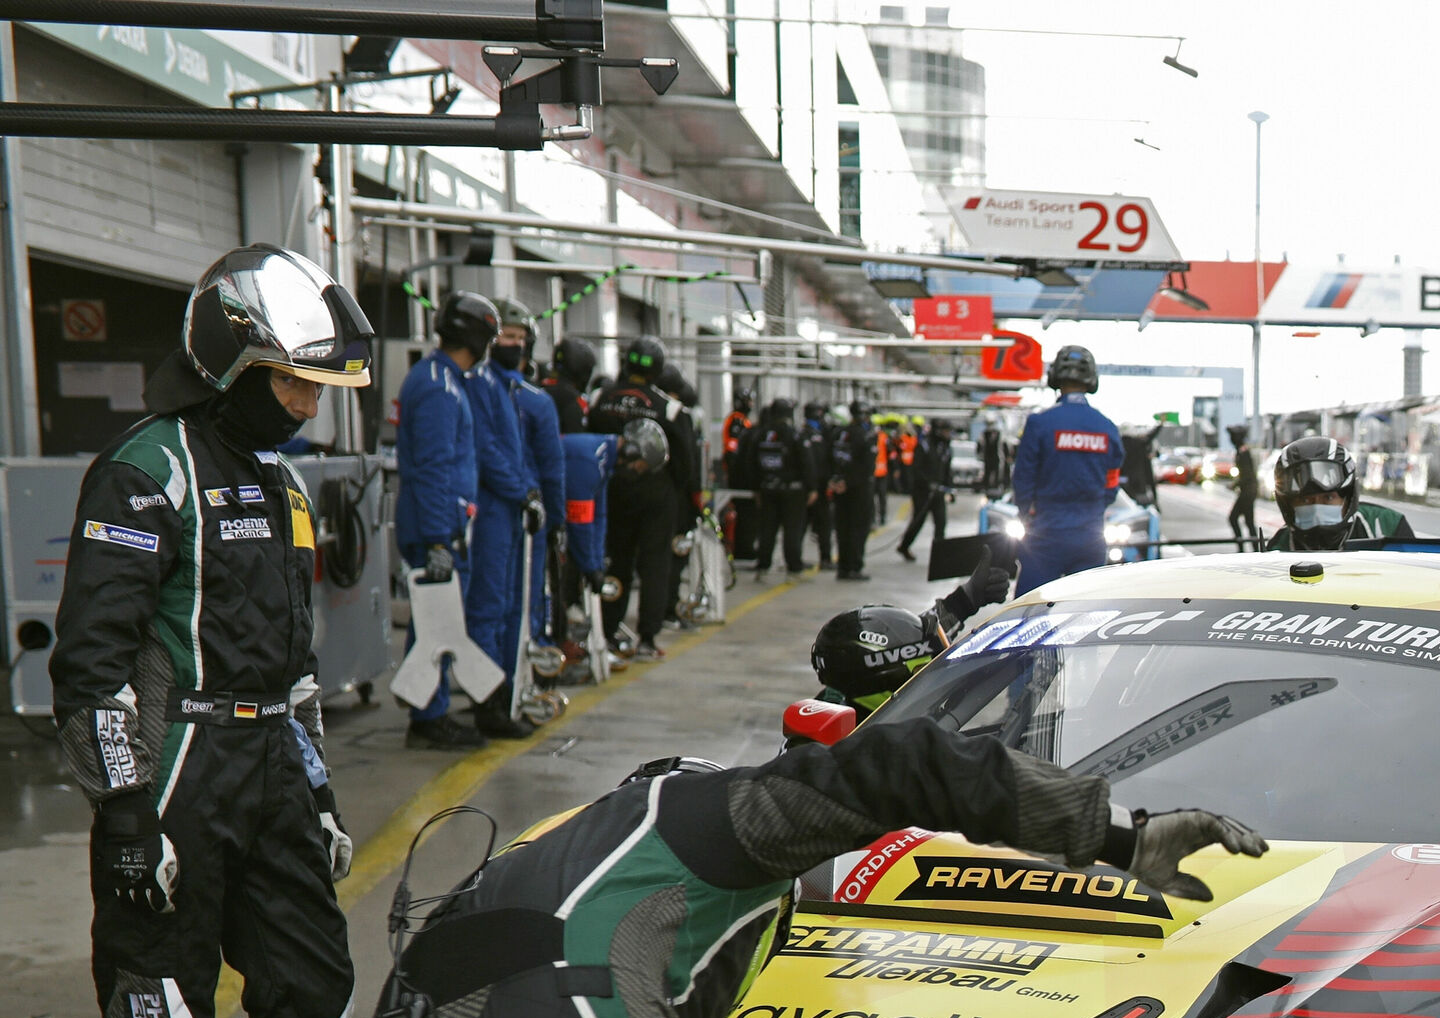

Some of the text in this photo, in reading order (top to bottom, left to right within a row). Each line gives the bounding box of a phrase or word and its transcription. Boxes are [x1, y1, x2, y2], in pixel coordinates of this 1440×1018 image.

[985, 198, 1074, 213] Audi Sport
[985, 214, 1073, 230] Team Land
[1077, 201, 1149, 253] 29
[1056, 433, 1107, 450] MOTUL
[219, 518, 269, 531] PHOENIX
[109, 530, 155, 547] MICHELIN
[1211, 610, 1348, 635] GRAN
[864, 641, 934, 668] uvex
[1207, 631, 1248, 641] THE
[1254, 633, 1305, 645] REAL
[1313, 637, 1397, 656] DRIVING
[110, 710, 138, 786] PHOENIX
[925, 866, 1151, 902] RAVENOL
[825, 958, 1080, 1005] Tiefbau GmbH
